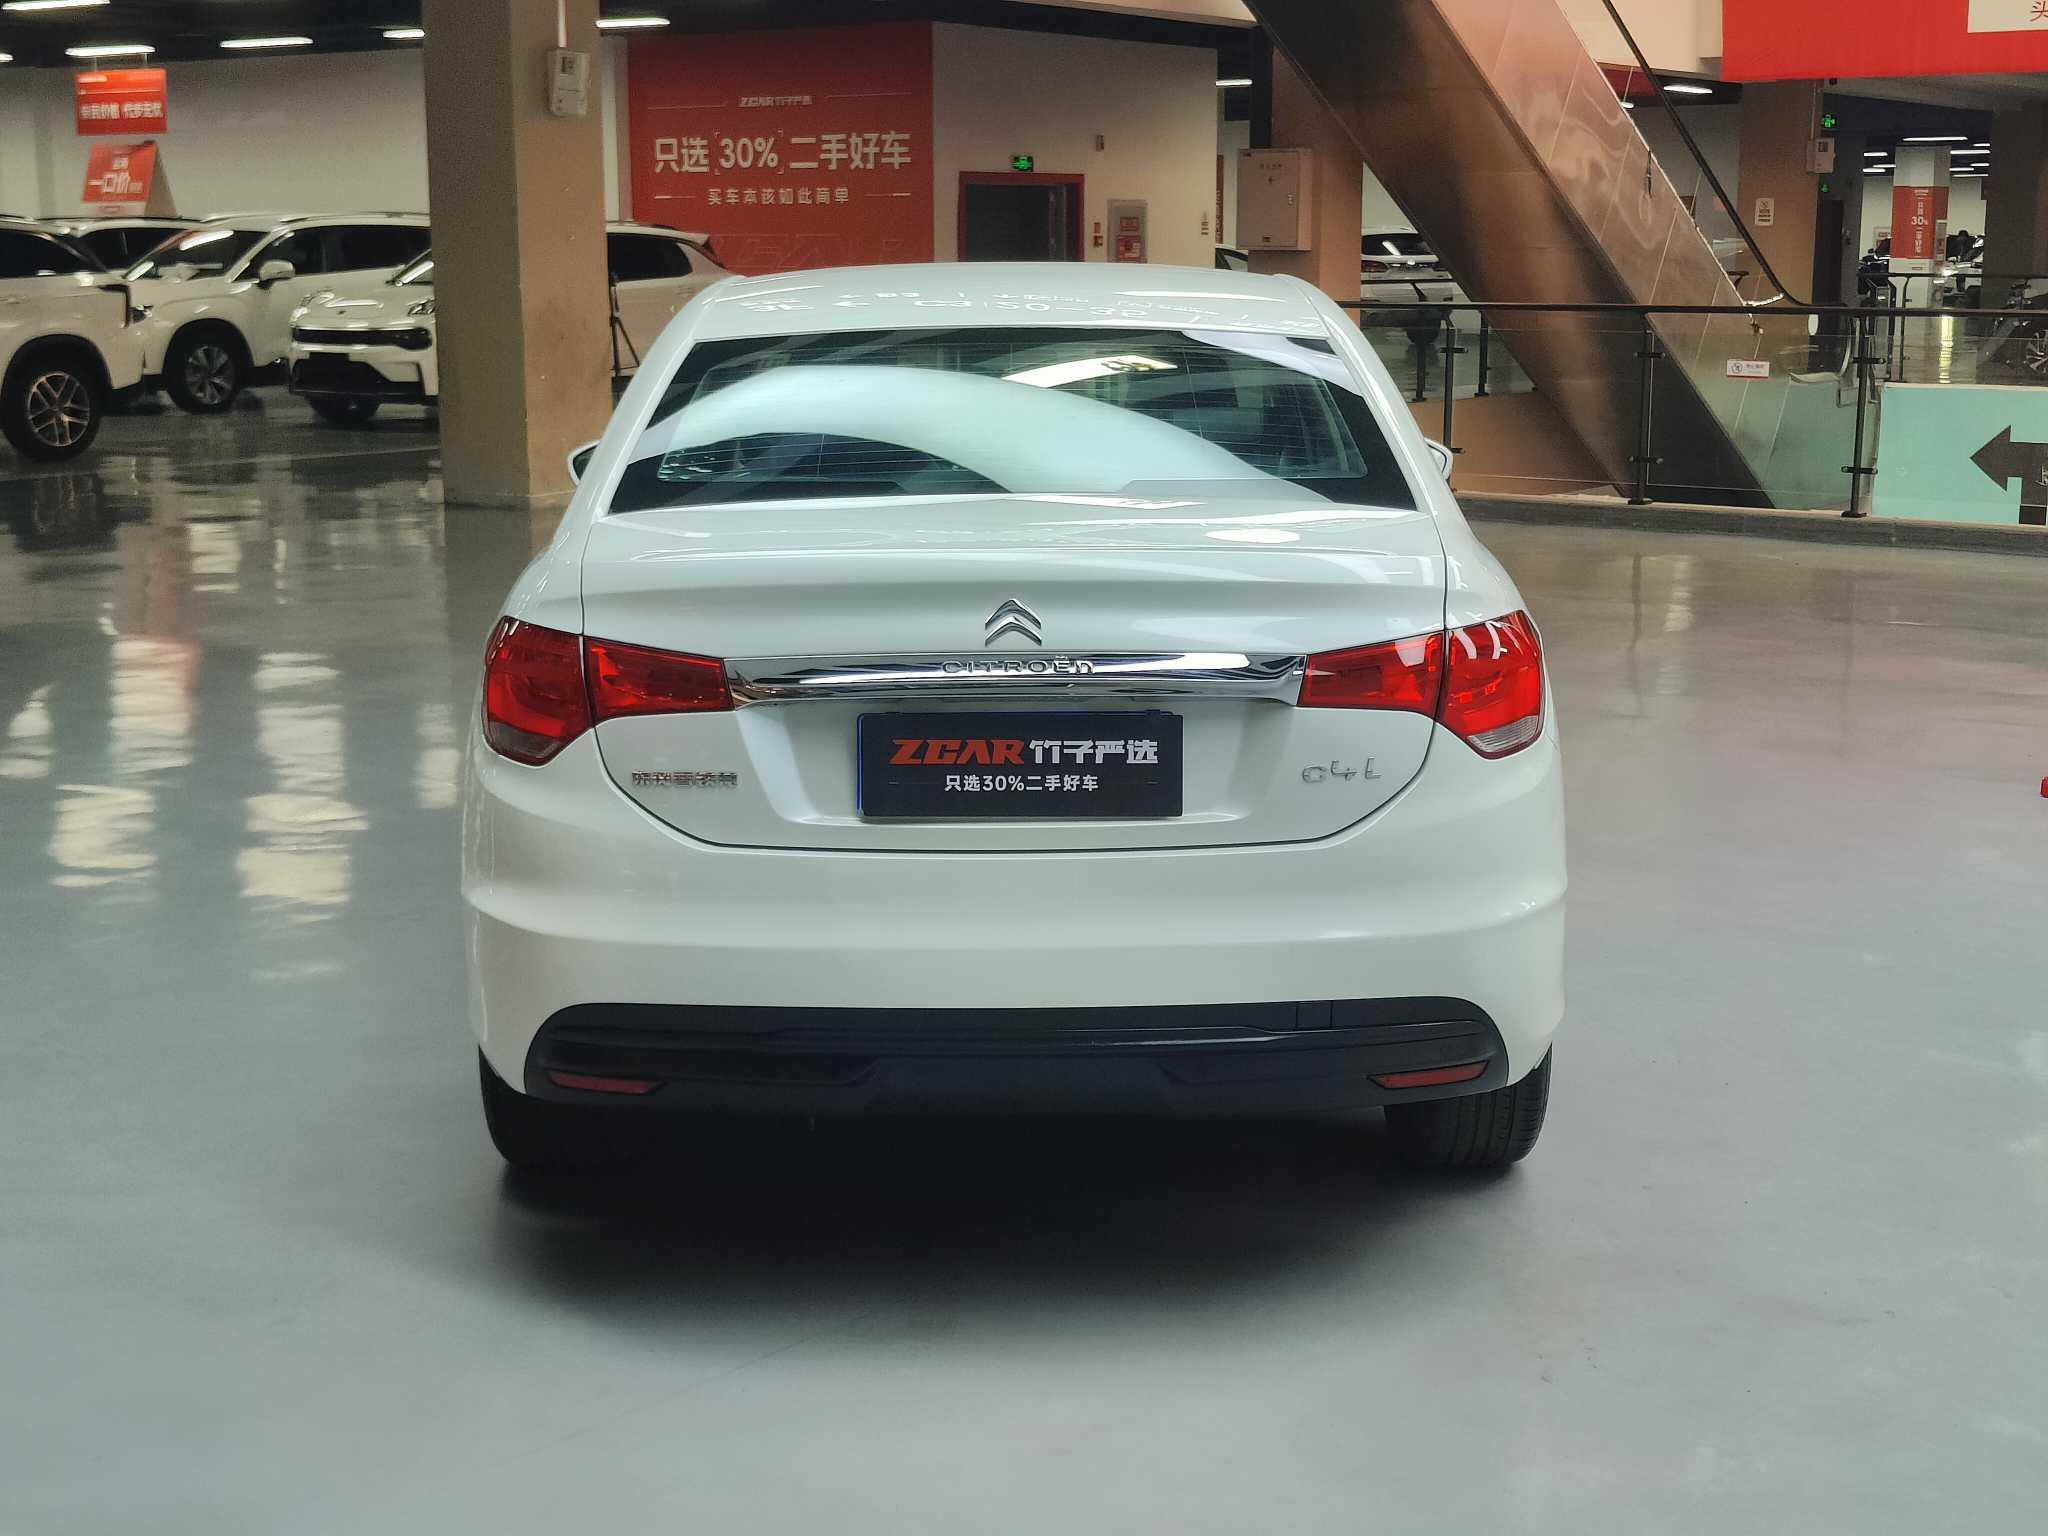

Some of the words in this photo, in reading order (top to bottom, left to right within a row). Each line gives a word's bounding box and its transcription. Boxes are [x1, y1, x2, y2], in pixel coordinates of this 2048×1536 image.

[655, 136, 710, 173] 只选
[719, 136, 779, 169] 30%
[790, 130, 912, 171] 二手好车
[707, 187, 850, 205] 买车本该如此简单
[888, 739, 1025, 765] ZCAR
[1029, 739, 1159, 764] 竹子严选
[943, 774, 1099, 792] 只选30%二手好车
